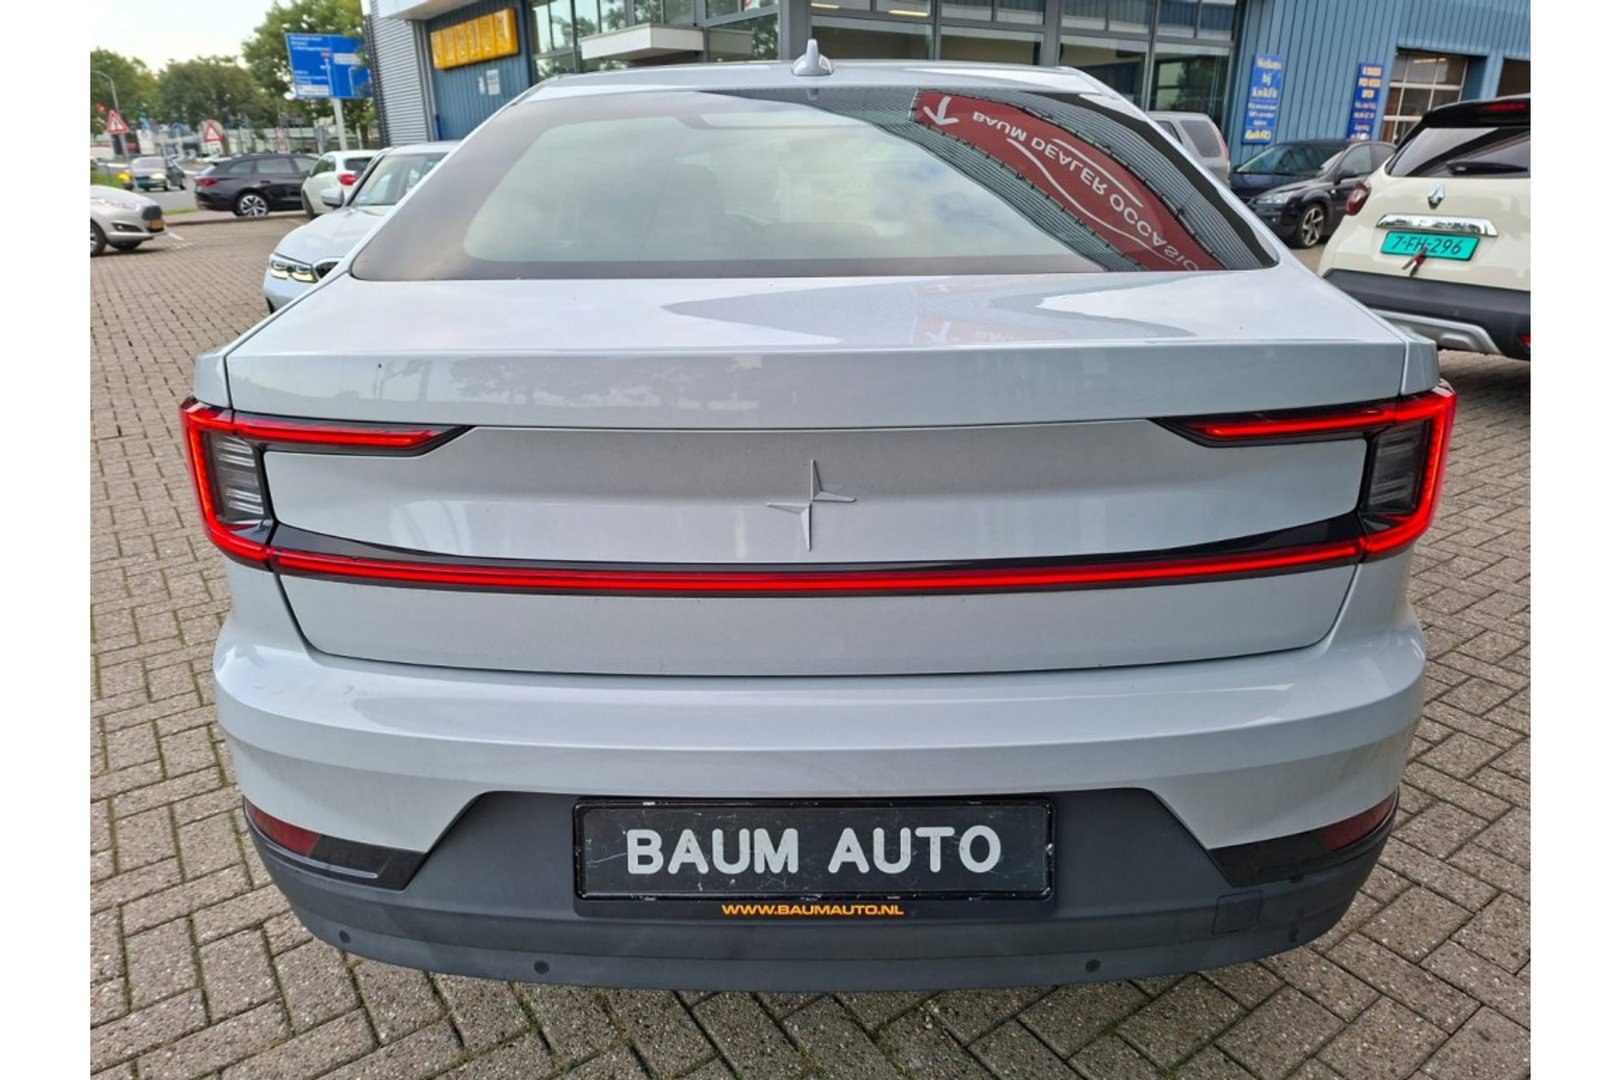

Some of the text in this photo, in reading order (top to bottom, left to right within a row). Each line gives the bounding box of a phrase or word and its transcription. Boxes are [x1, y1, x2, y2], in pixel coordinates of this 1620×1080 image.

[1391, 235, 1463, 255] 7-FH-296
[626, 825, 1002, 875] BAUM AUTO
[721, 904, 905, 916] WWW.BAUMAUTO.NL
